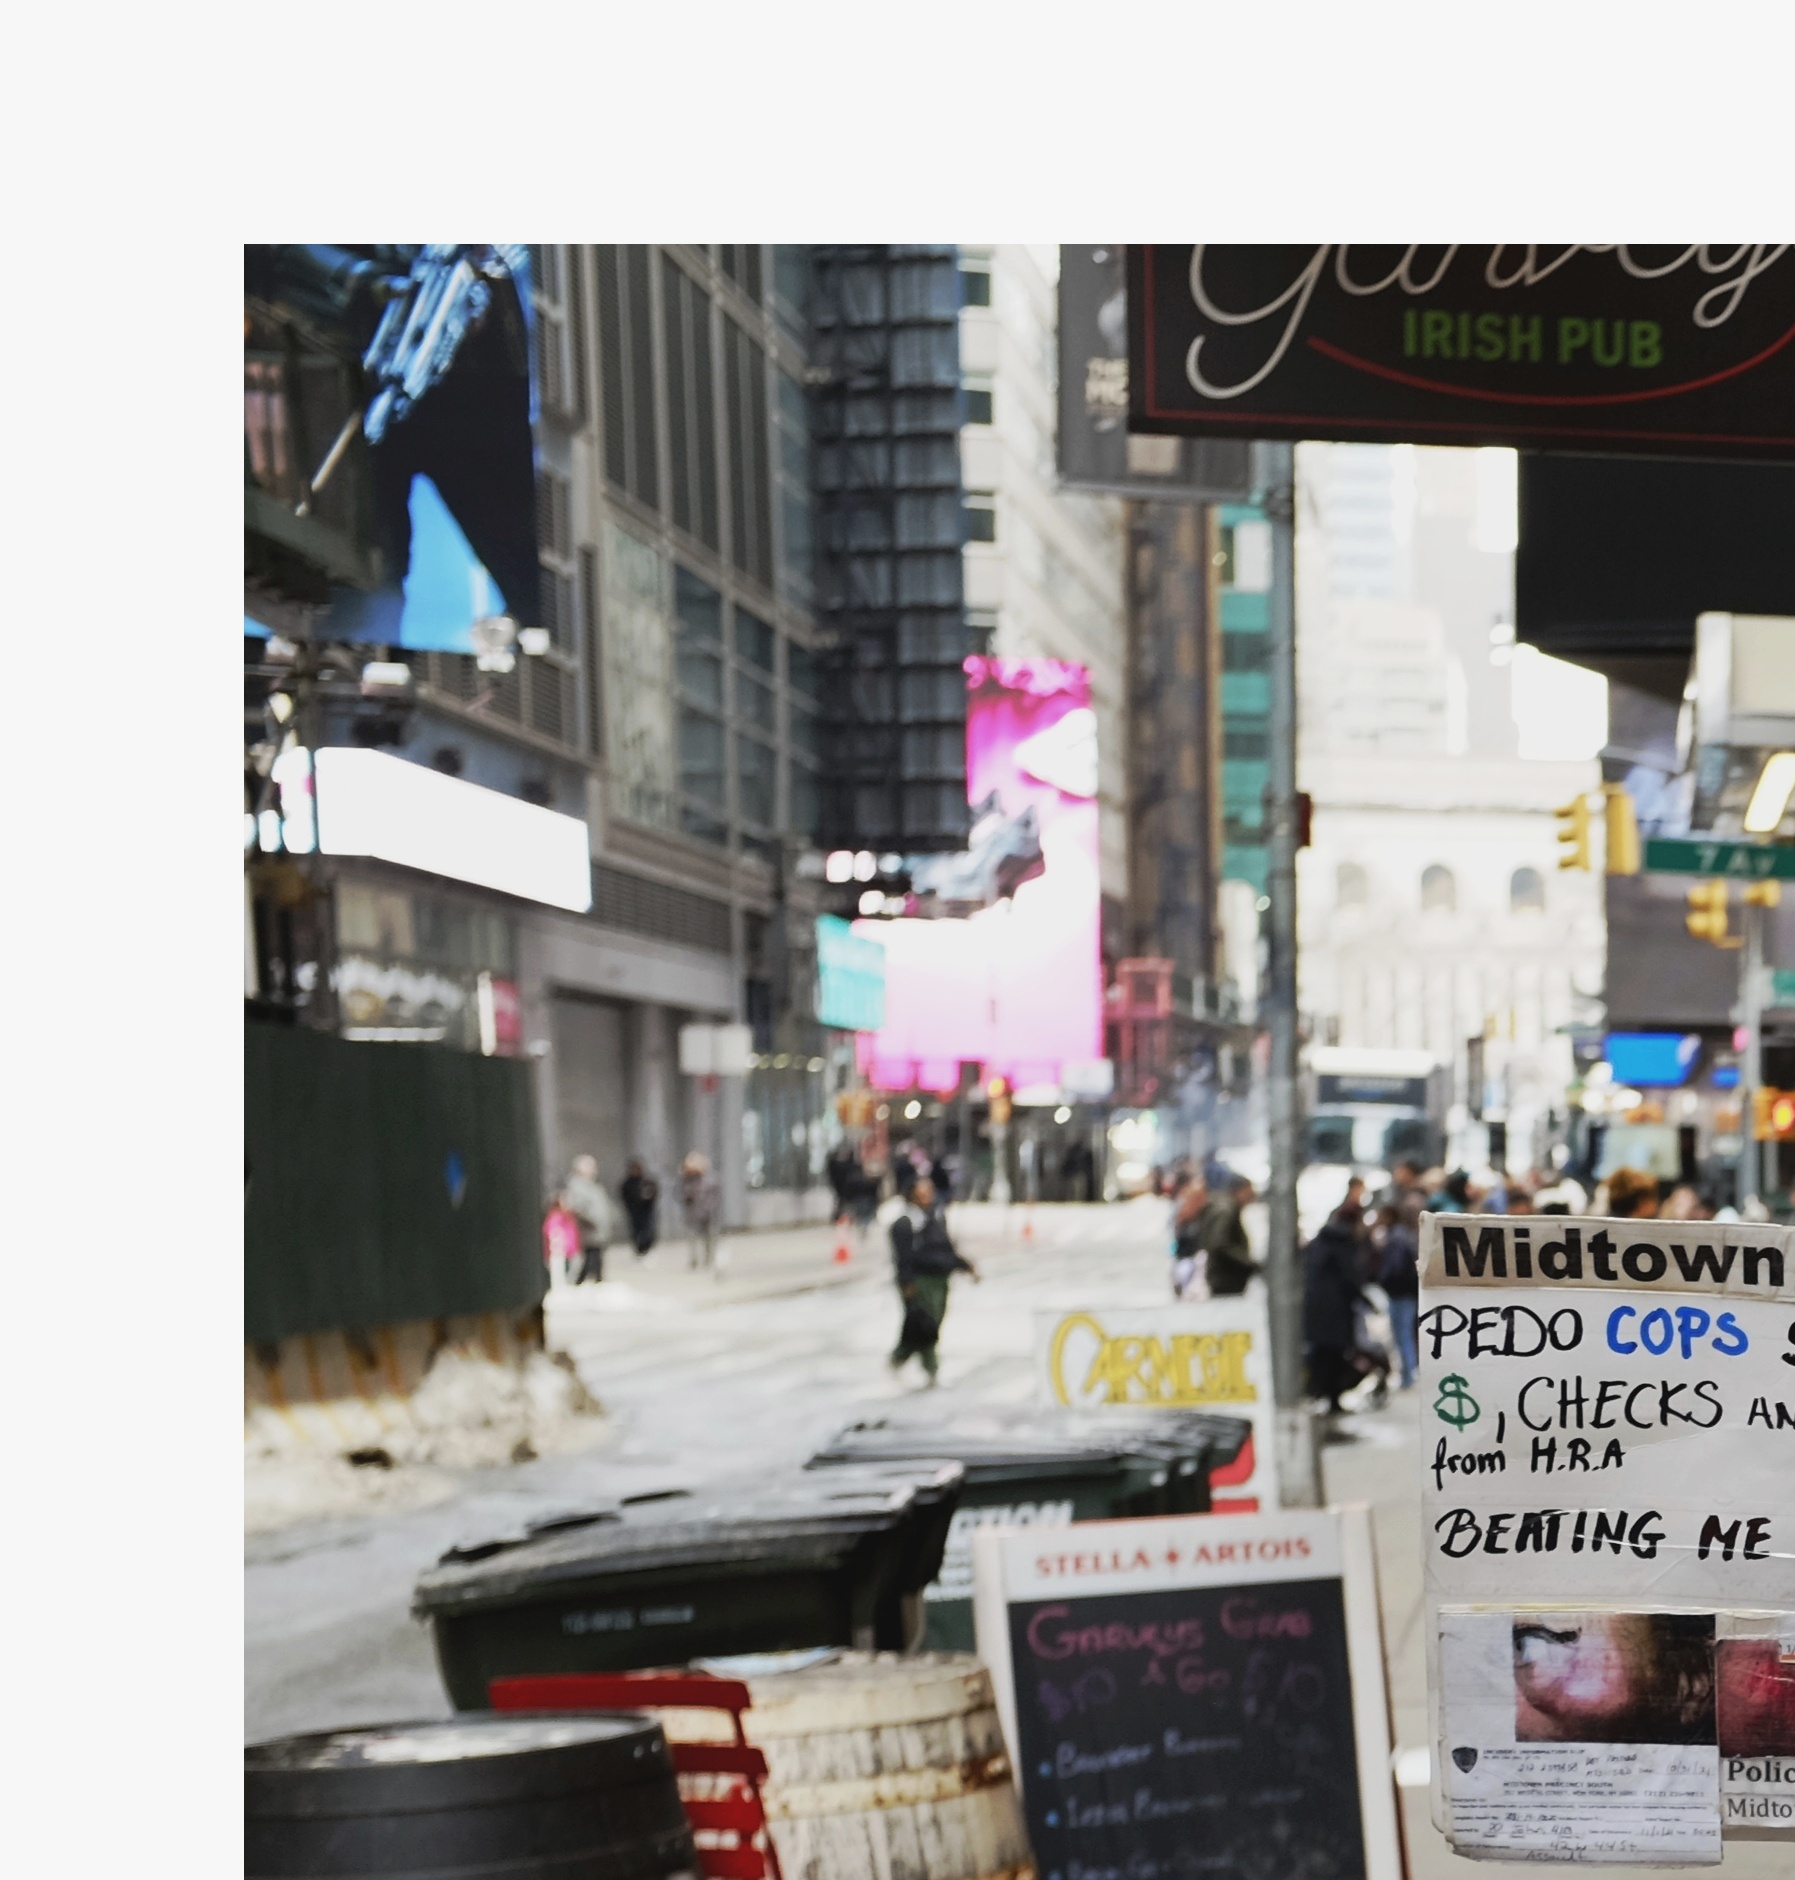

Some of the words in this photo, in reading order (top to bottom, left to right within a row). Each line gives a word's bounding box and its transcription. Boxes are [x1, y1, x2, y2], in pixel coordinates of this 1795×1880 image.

[1403, 308, 1543, 363] IRISH
[1557, 316, 1664, 369] PUB
[1442, 1227, 1784, 1287] Midtown
[1419, 1304, 1583, 1360] PEDO
[1606, 1305, 1749, 1360] COPS
[1518, 1376, 1723, 1431] CHECKS
[1431, 1437, 1506, 1491] from
[1531, 1436, 1626, 1474] H.R.A
[1035, 1549, 1151, 1581] STELLA
[1193, 1537, 1312, 1566] ARTOIS
[1435, 1508, 1666, 1559] BEATING
[1698, 1515, 1772, 1561] ME
